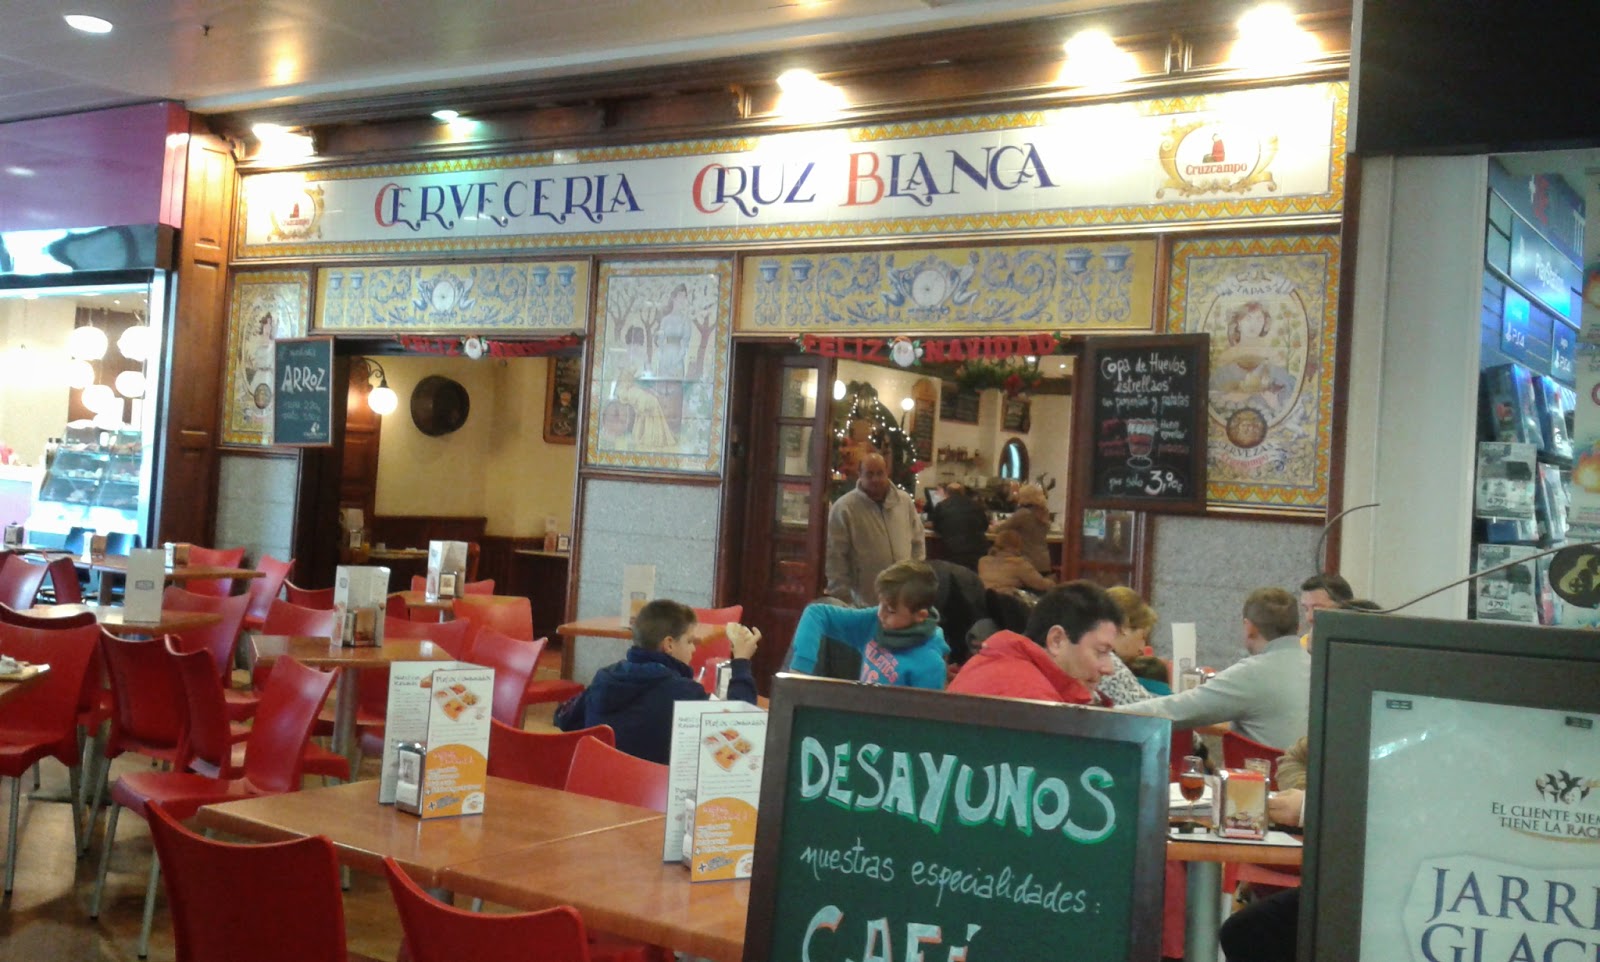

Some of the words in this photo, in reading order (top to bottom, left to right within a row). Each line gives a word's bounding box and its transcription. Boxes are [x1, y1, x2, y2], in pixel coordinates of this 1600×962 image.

[1185, 162, 1248, 176] Cruzcampo
[374, 172, 644, 231] CERVECERIA
[691, 161, 817, 218] CRUZ
[838, 142, 1061, 207] BLANCA
[803, 333, 886, 363] FELIZ
[923, 334, 1056, 364] NAVIDAD
[281, 364, 327, 394] ARROZ
[1101, 356, 1131, 381] Copa
[1136, 356, 1147, 373] de
[1150, 352, 1187, 376] Huevos
[800, 735, 1117, 845] DESAYUNOS
[1491, 801, 1507, 816] EL
[1510, 805, 1571, 822] CLIENTE
[1499, 816, 1540, 832] TIENE
[1545, 820, 1562, 834] LA
